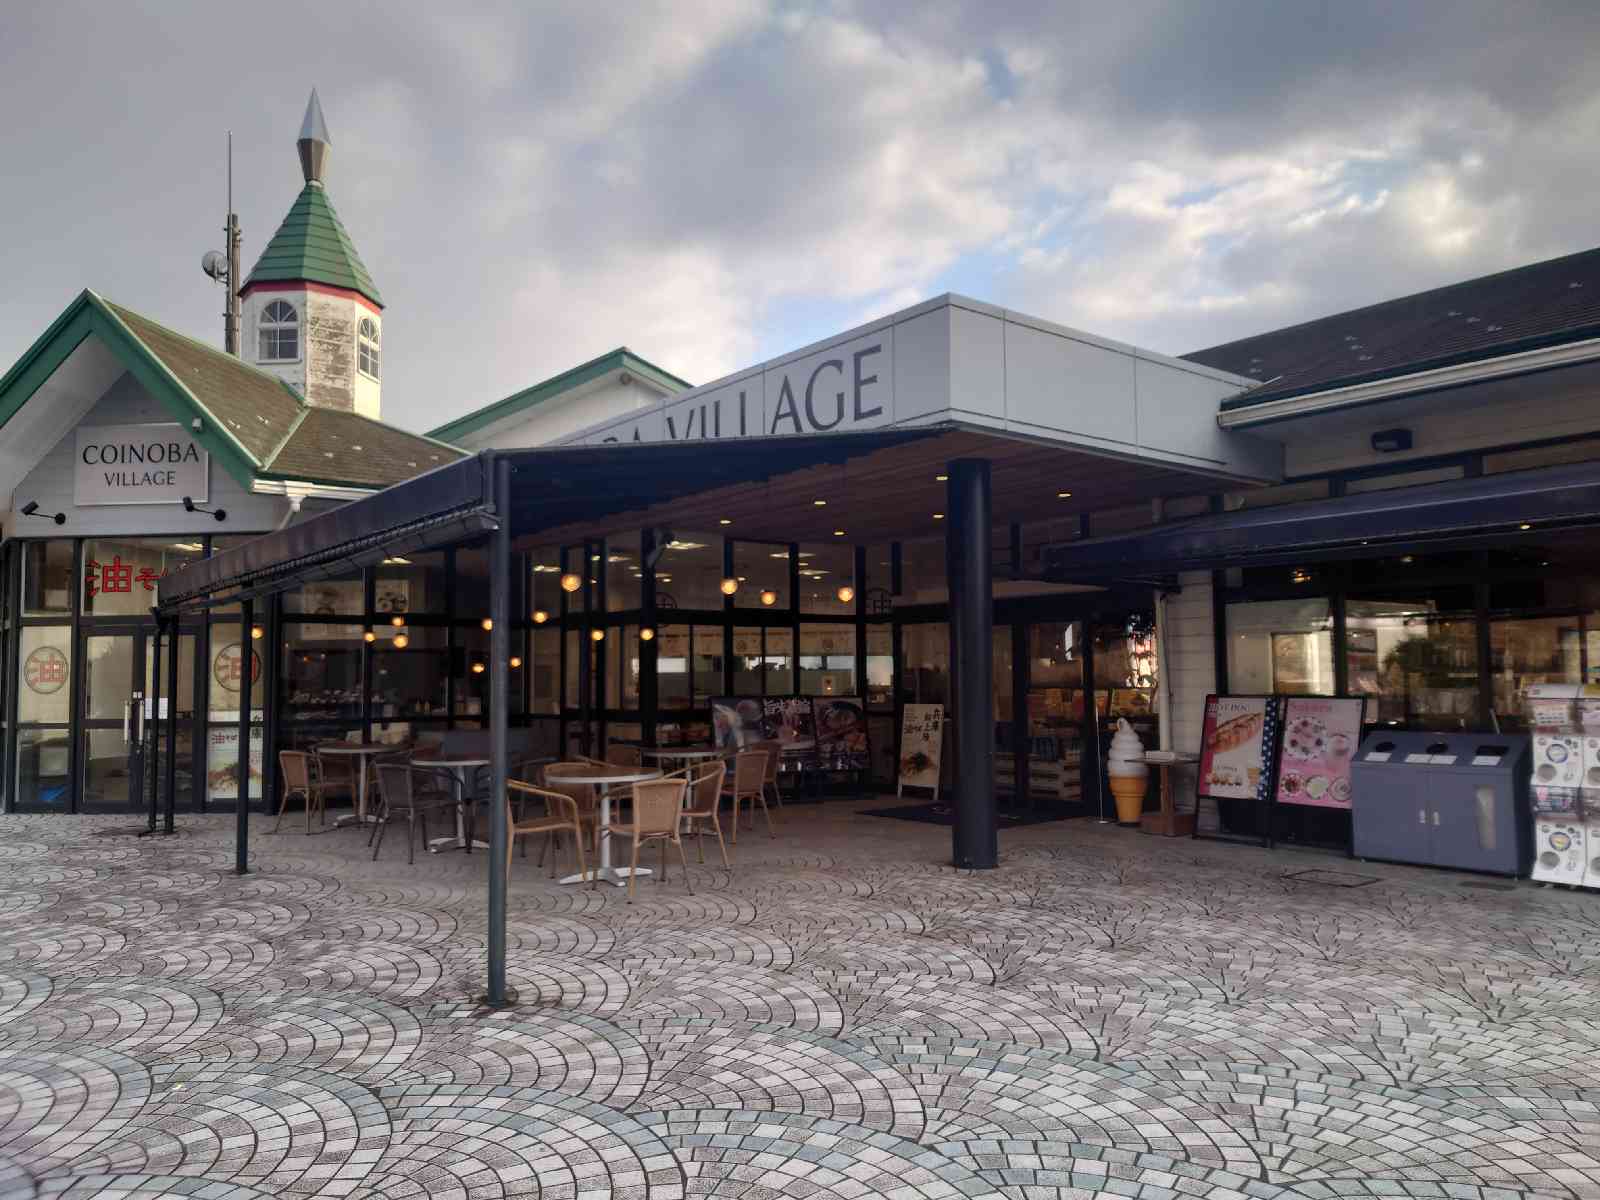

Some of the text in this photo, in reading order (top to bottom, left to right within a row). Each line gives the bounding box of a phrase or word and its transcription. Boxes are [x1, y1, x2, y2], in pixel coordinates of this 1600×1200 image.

[82, 442, 200, 465] COINOBA
[104, 470, 177, 487] VILLAGE
[85, 555, 169, 597] 油そ
[31, 654, 65, 688] 油
